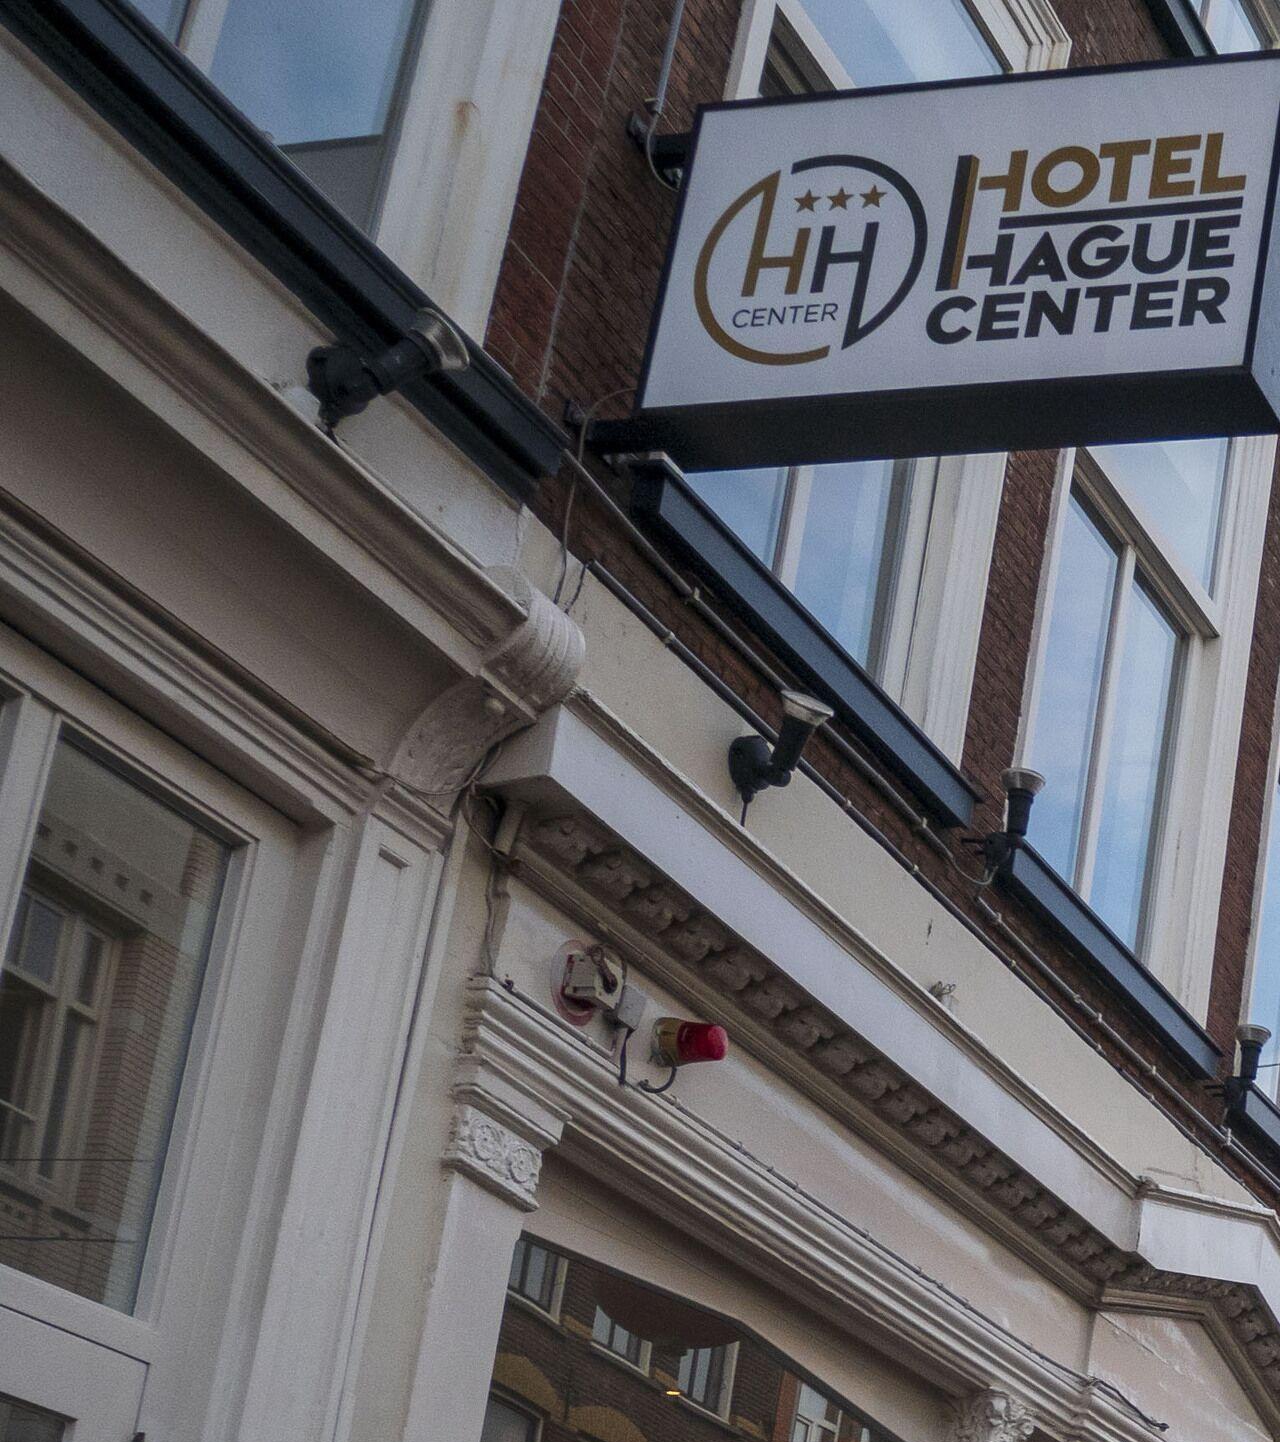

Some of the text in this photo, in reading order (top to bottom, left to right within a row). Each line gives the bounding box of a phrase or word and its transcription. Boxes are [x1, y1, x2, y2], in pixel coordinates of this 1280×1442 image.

[946, 132, 1247, 212] HOTEL
[936, 214, 1242, 291] HAGUE
[732, 302, 839, 328] CENTER
[925, 276, 1231, 345] CENTER
